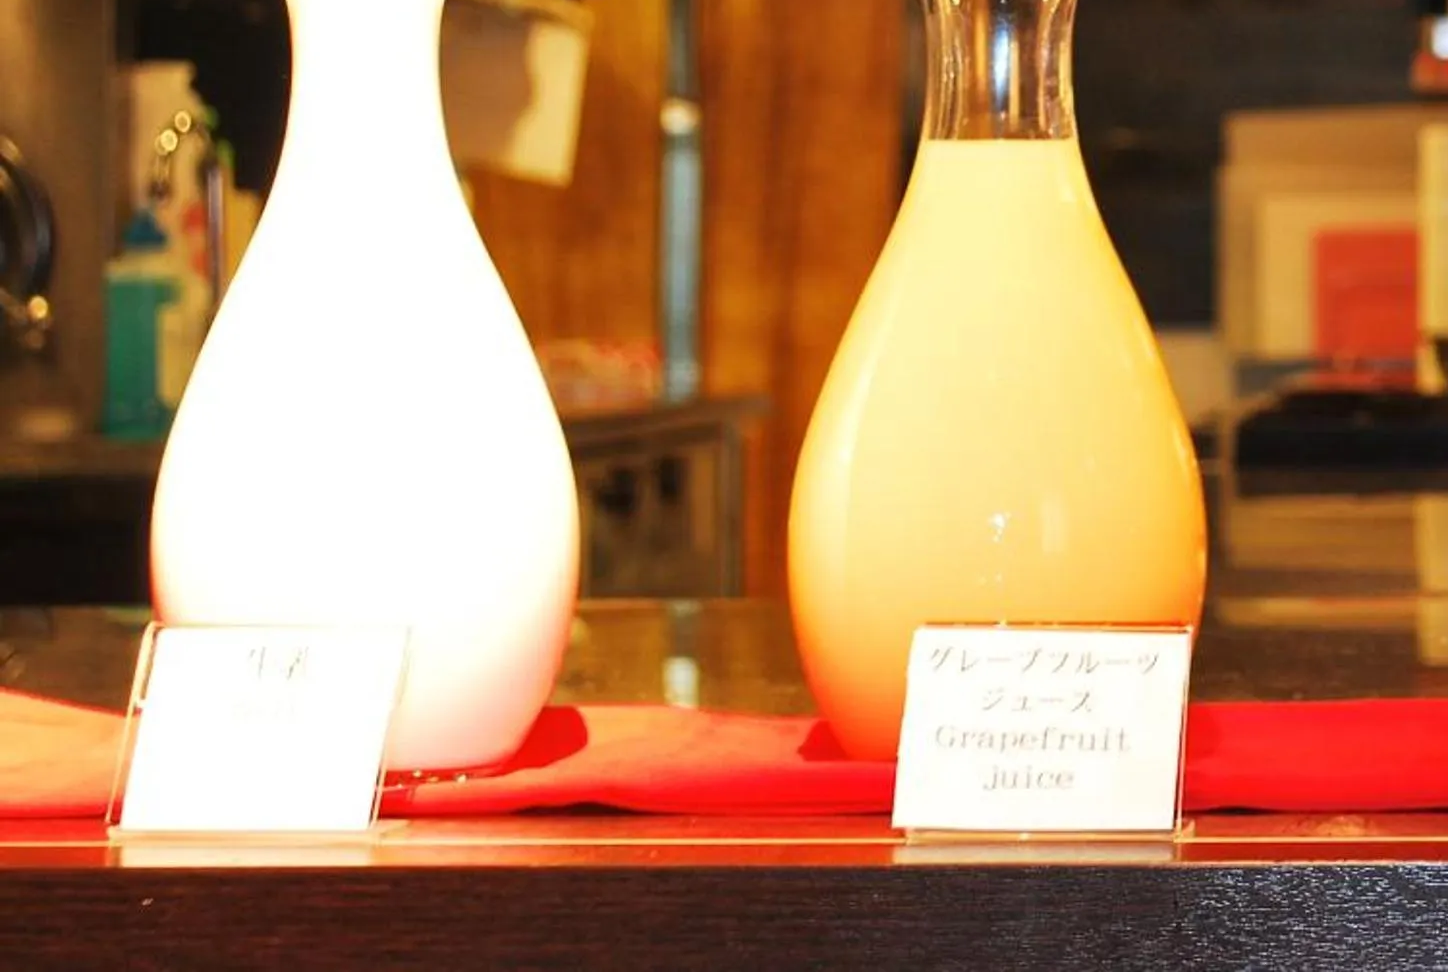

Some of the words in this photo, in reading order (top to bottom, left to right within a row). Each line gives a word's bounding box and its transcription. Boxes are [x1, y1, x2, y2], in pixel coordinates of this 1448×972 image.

[981, 684, 1093, 714] ジュース
[935, 724, 1131, 753] Grapefruit
[982, 763, 1076, 791] juice
